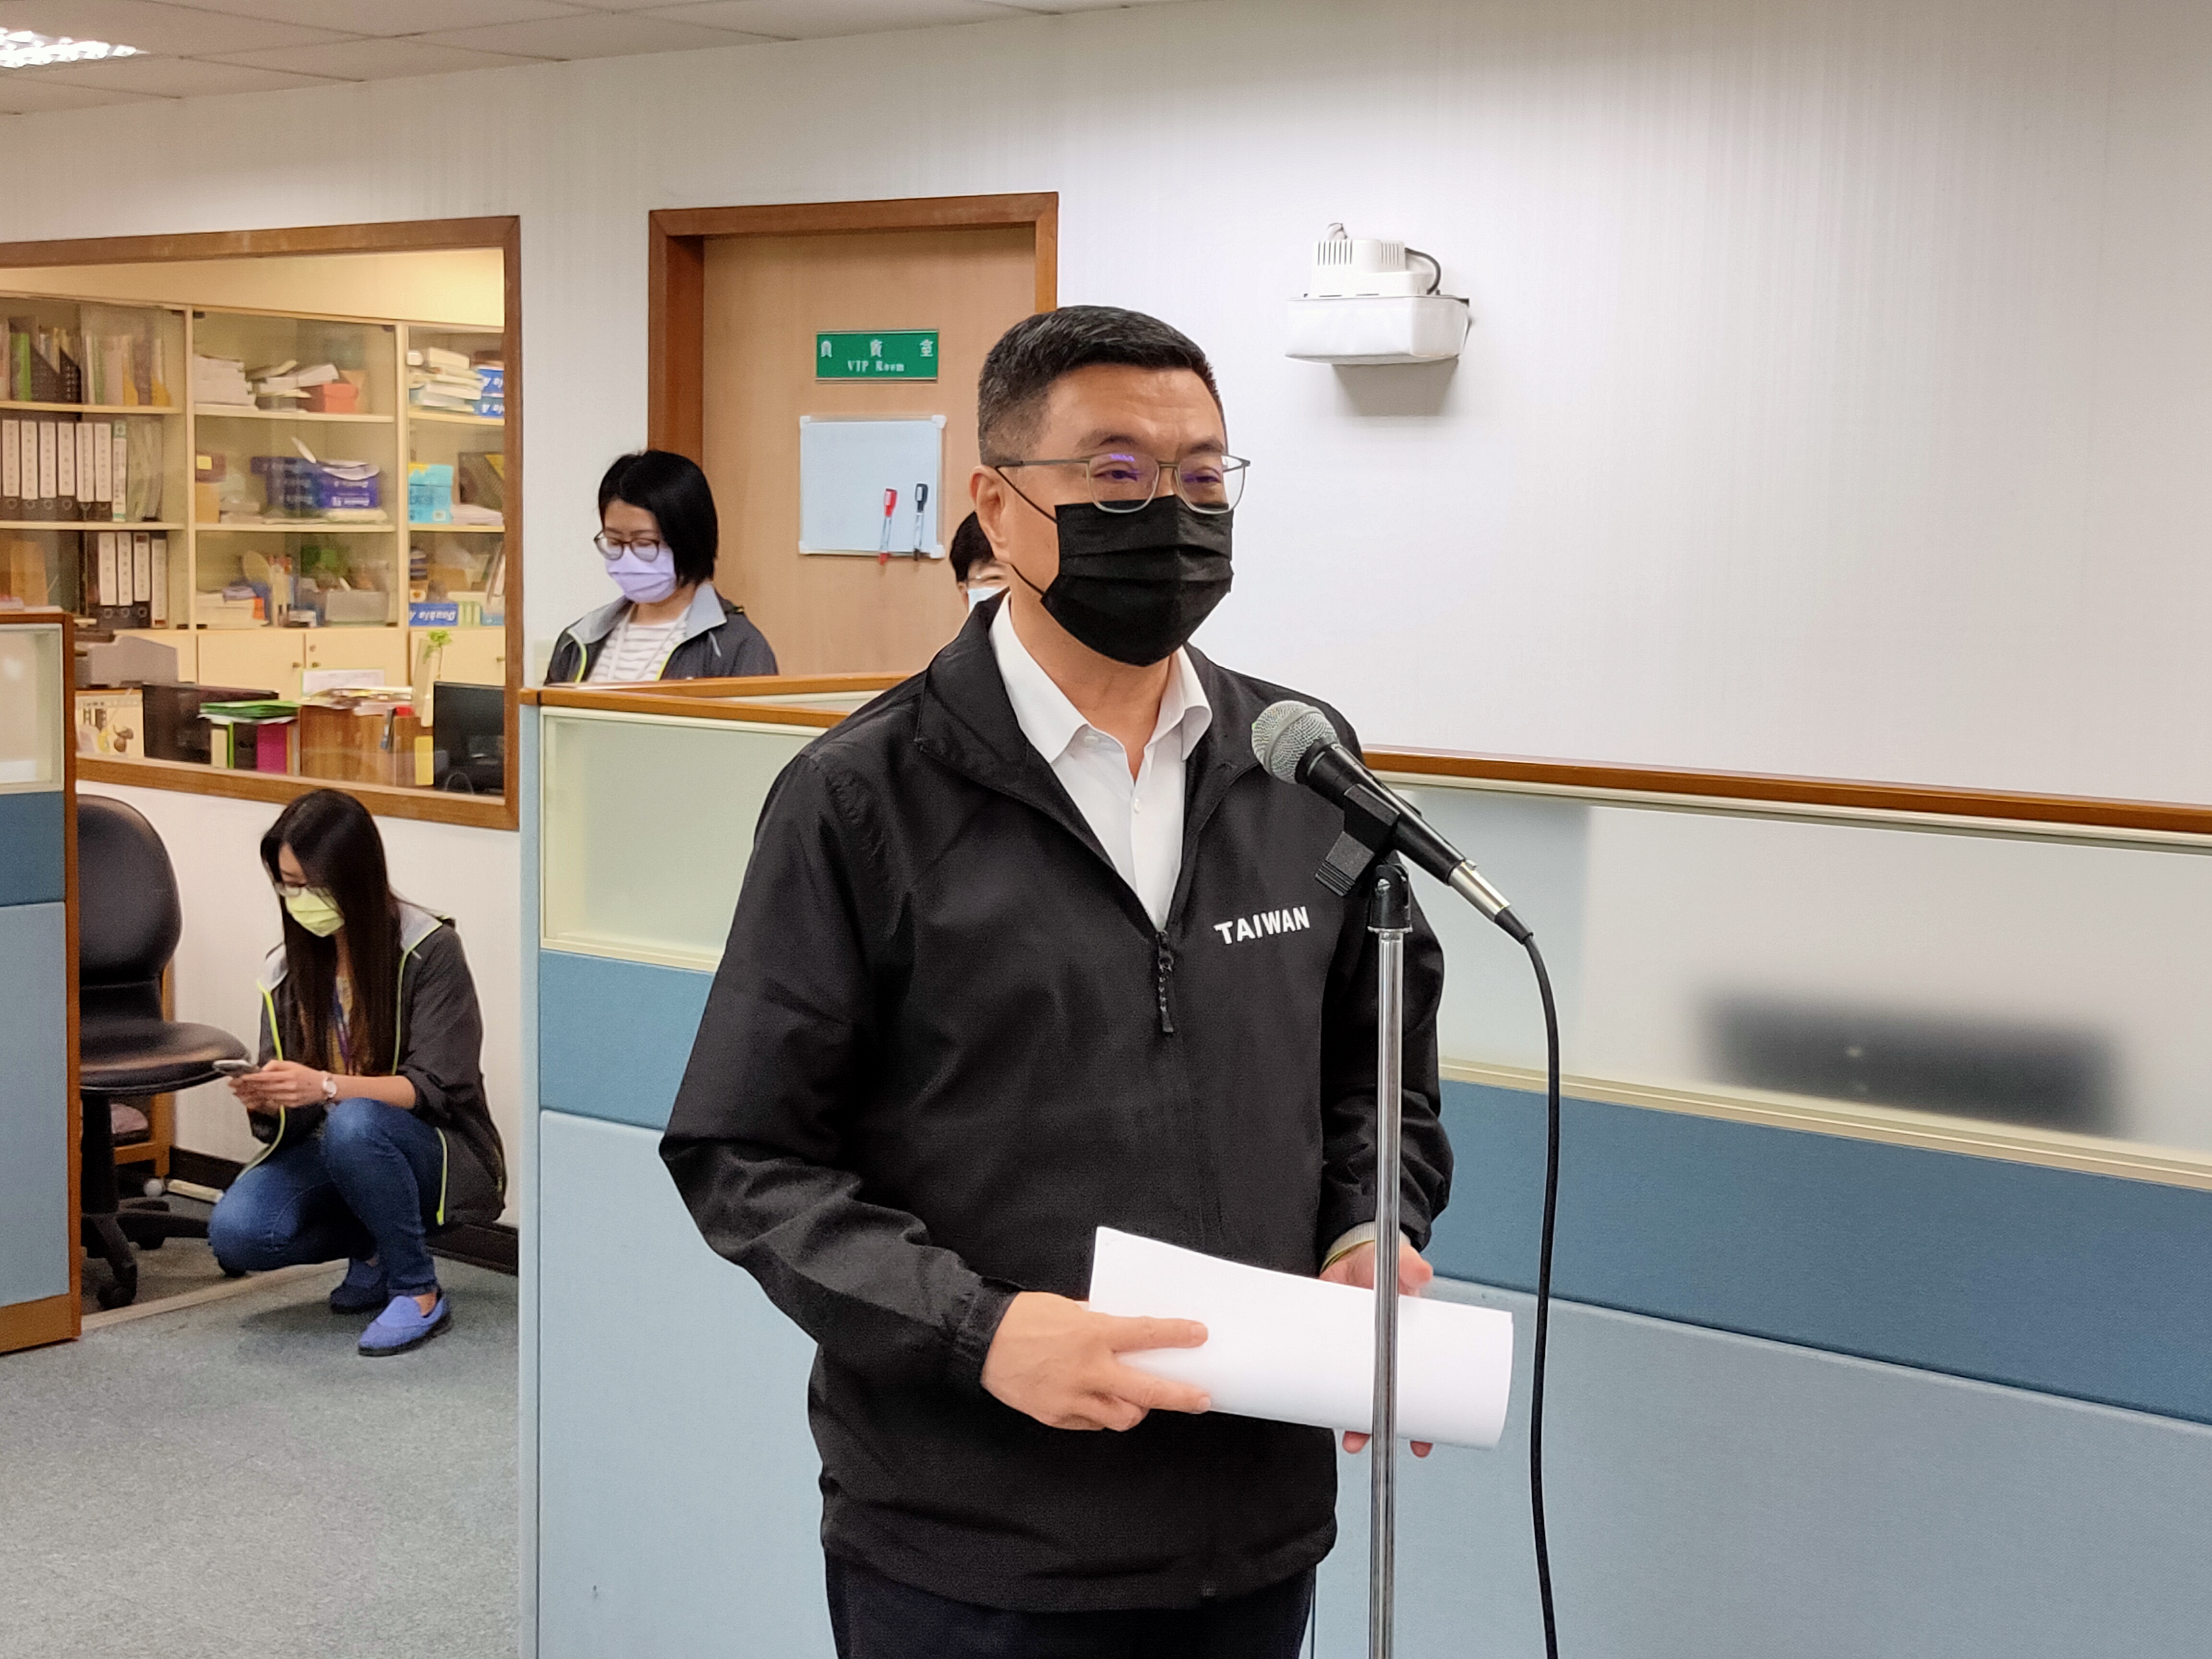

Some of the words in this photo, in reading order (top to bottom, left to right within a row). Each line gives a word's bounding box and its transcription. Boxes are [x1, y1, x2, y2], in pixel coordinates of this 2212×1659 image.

[847, 360, 869, 373] VIP
[875, 360, 904, 372] Room
[419, 611, 456, 621] Double
[1213, 906, 1310, 945] TAIWAN
